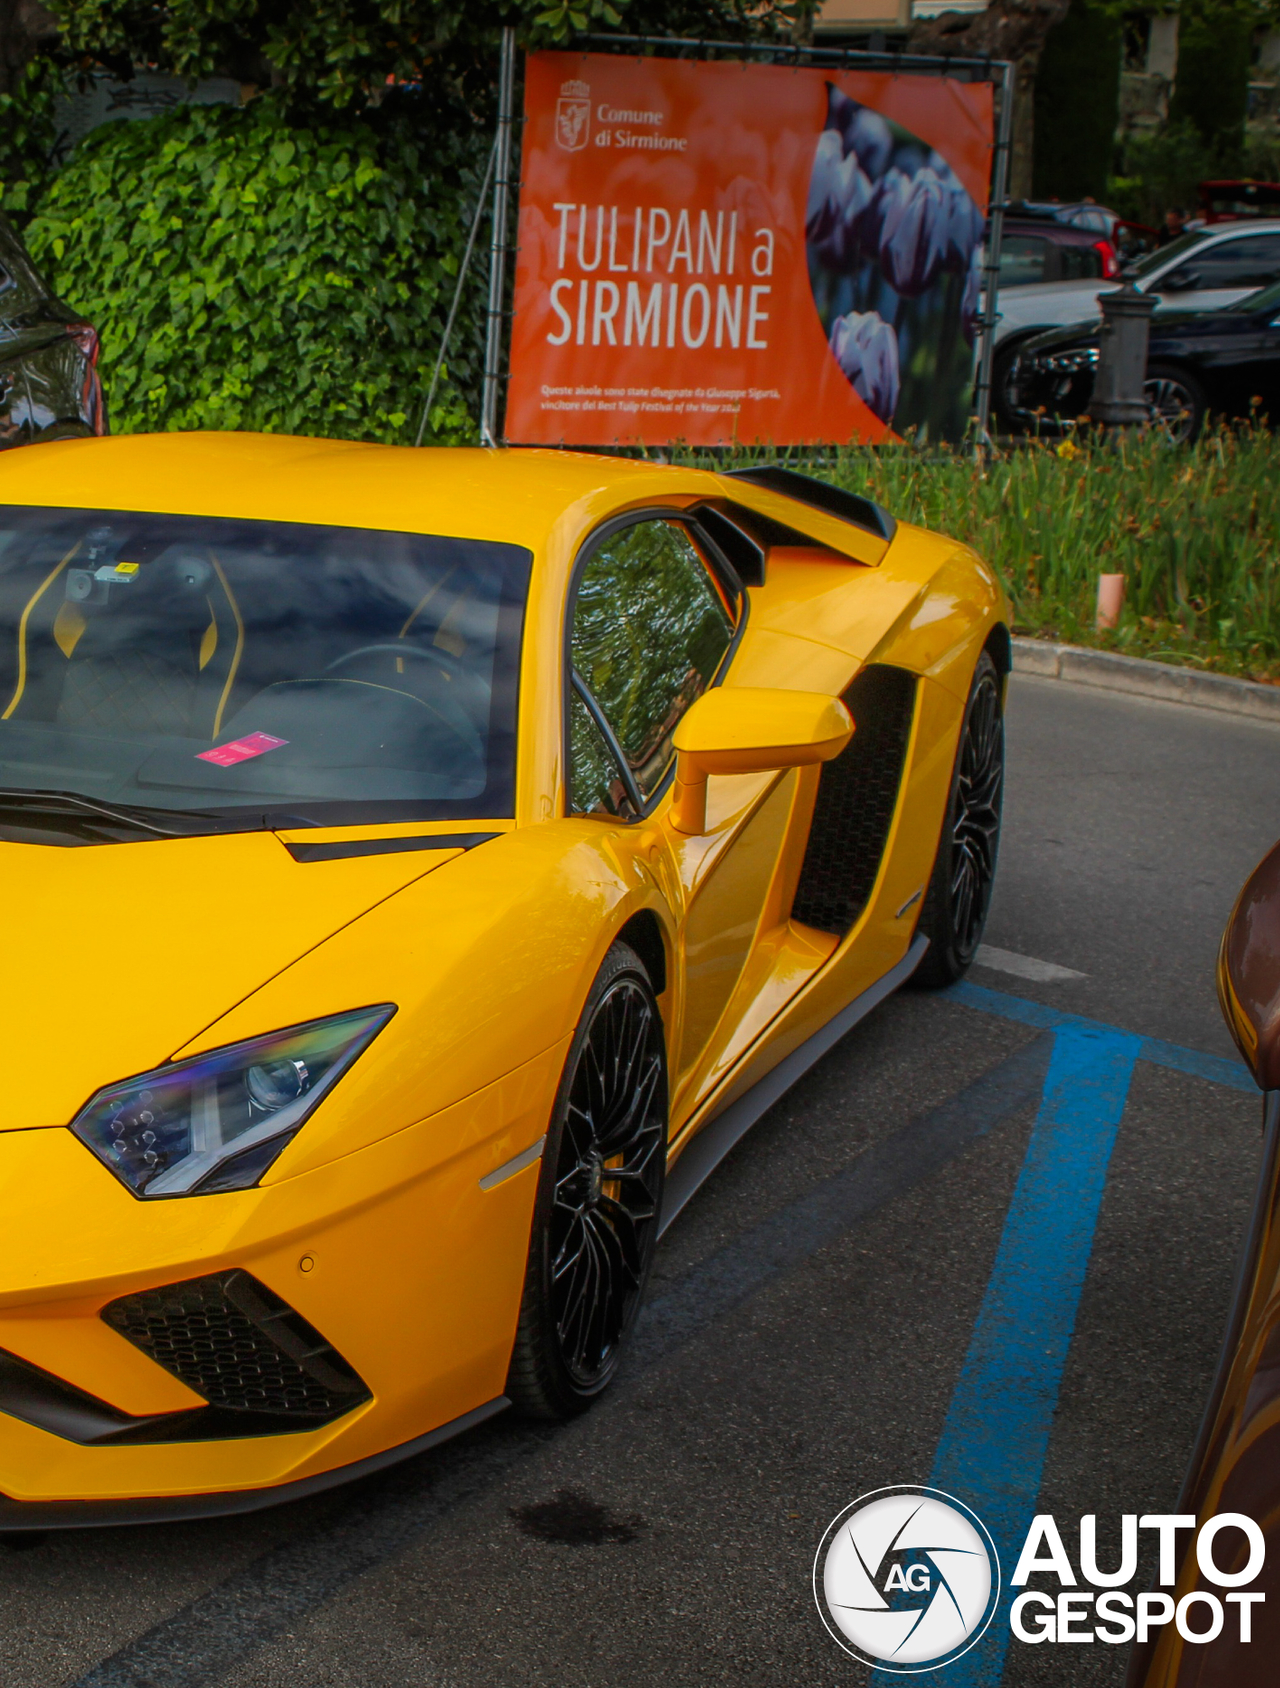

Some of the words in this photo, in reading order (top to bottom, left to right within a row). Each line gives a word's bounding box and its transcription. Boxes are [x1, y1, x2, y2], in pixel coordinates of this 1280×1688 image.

[597, 104, 663, 125] Comune
[595, 130, 611, 147] di
[615, 129, 687, 150] Sirmione
[553, 203, 738, 275] TULIPANI
[751, 228, 774, 277] a
[546, 278, 771, 349] SIRMIONE
[541, 385, 573, 398] Queste
[604, 387, 625, 396] sono
[627, 386, 649, 397] state
[706, 387, 746, 401] Giuseppe
[598, 401, 617, 411] Best
[619, 401, 640, 413] Tulip
[641, 402, 674, 412] Festival
[686, 402, 700, 412] the
[701, 402, 721, 413] Year
